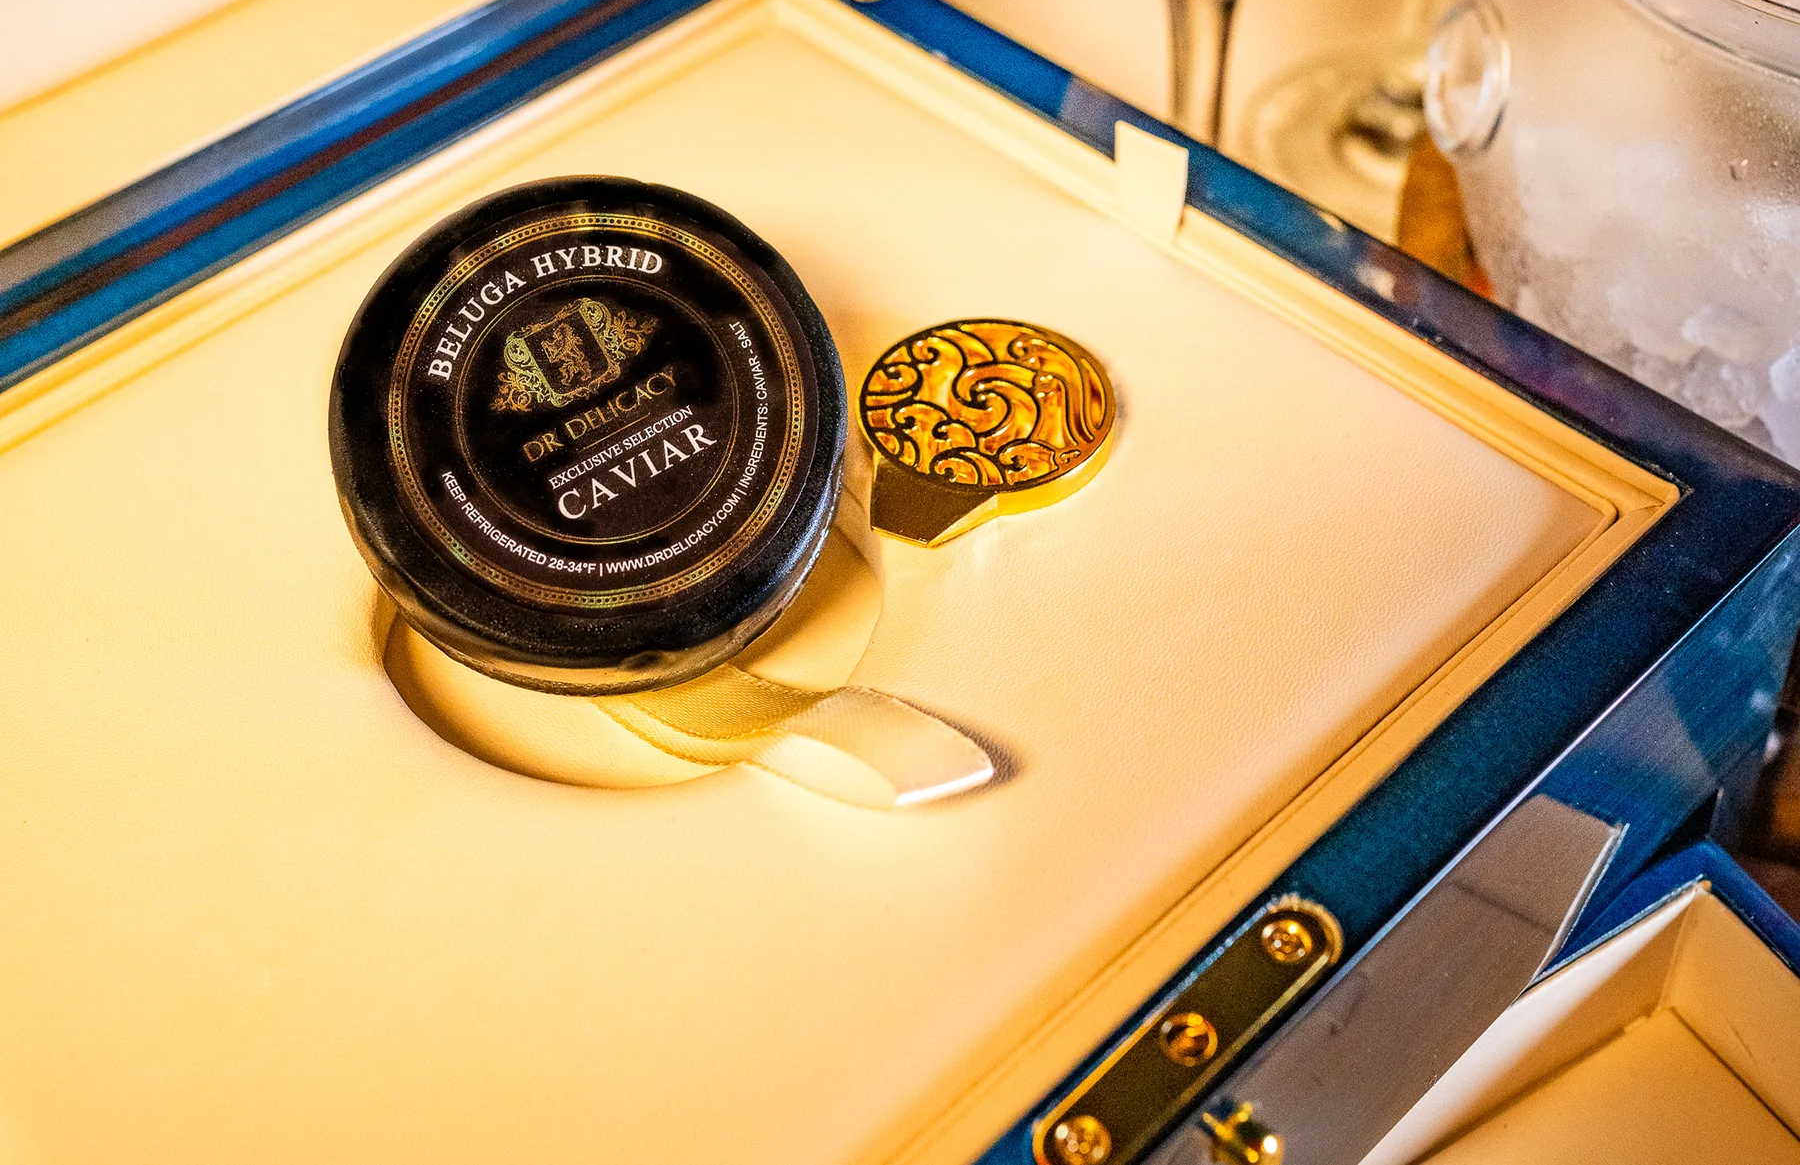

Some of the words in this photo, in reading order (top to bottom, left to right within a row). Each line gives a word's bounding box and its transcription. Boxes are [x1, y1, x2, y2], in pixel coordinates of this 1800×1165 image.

[428, 270, 527, 381] BELUGA
[530, 245, 663, 278] HYBRID
[729, 321, 752, 349] SALT
[522, 433, 564, 463] DR
[565, 365, 677, 441] DELICACY
[748, 355, 768, 401] CAVIAR
[548, 443, 623, 489] EXCLUSIVE
[622, 405, 694, 451] SELECTION
[558, 424, 717, 520] CAVIAR
[738, 402, 769, 489] INGREDIENTS:
[442, 471, 467, 504] KEEP
[461, 501, 547, 565] REFRIGERATED
[606, 492, 741, 572] WWW.DRDELICACY.COM
